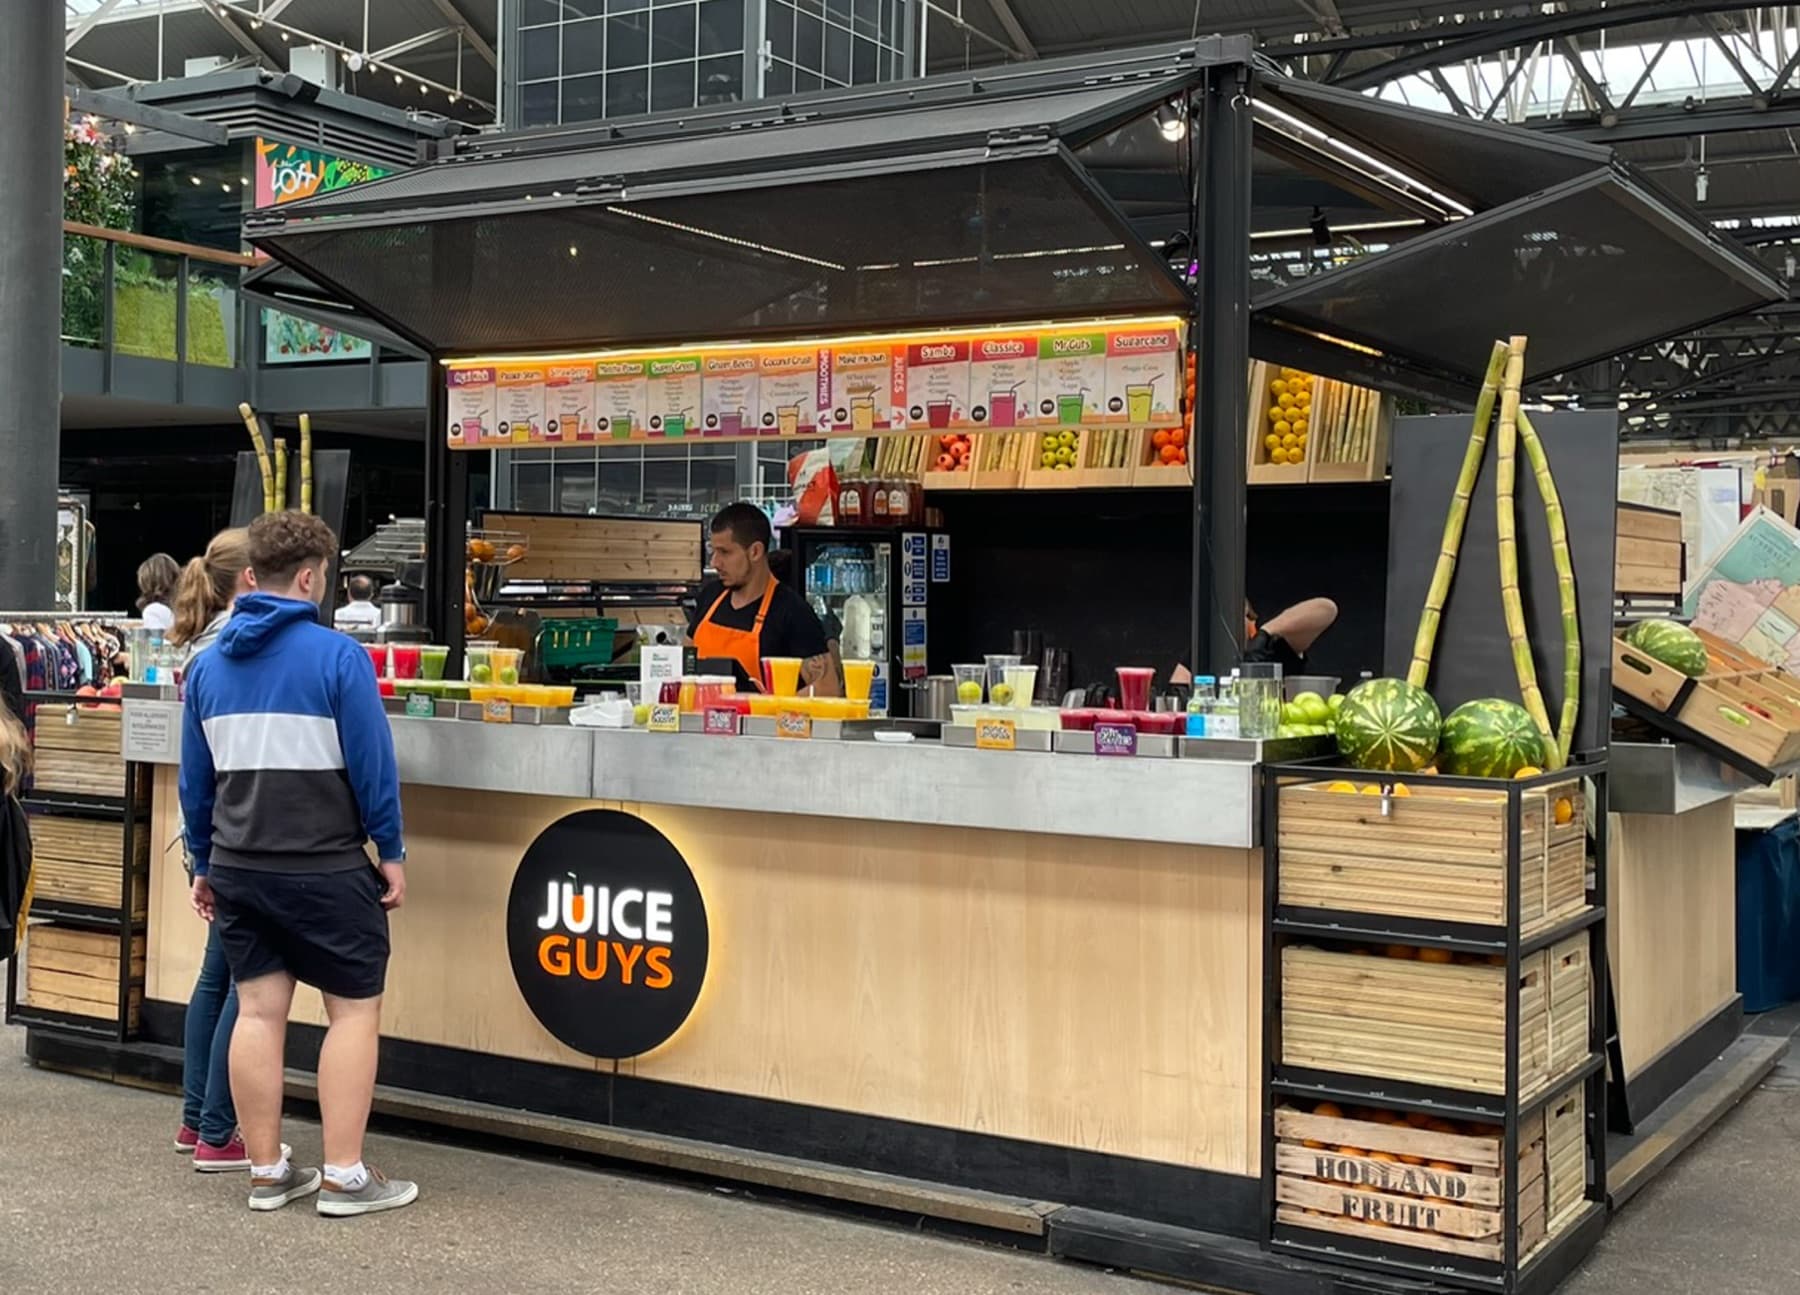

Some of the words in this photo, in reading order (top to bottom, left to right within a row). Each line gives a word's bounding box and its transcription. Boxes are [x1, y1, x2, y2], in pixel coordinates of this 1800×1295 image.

[921, 345, 956, 358] Samba
[983, 341, 1024, 354] Classica
[1115, 335, 1168, 347] Sugarcane
[819, 349, 830, 405] SMOOTHIES
[893, 356, 905, 393] JUICES
[537, 880, 673, 943] JUICE
[538, 934, 673, 988] GUYS
[1315, 1156, 1467, 1199] HOLLAND
[1342, 1193, 1441, 1230] FRUIT
